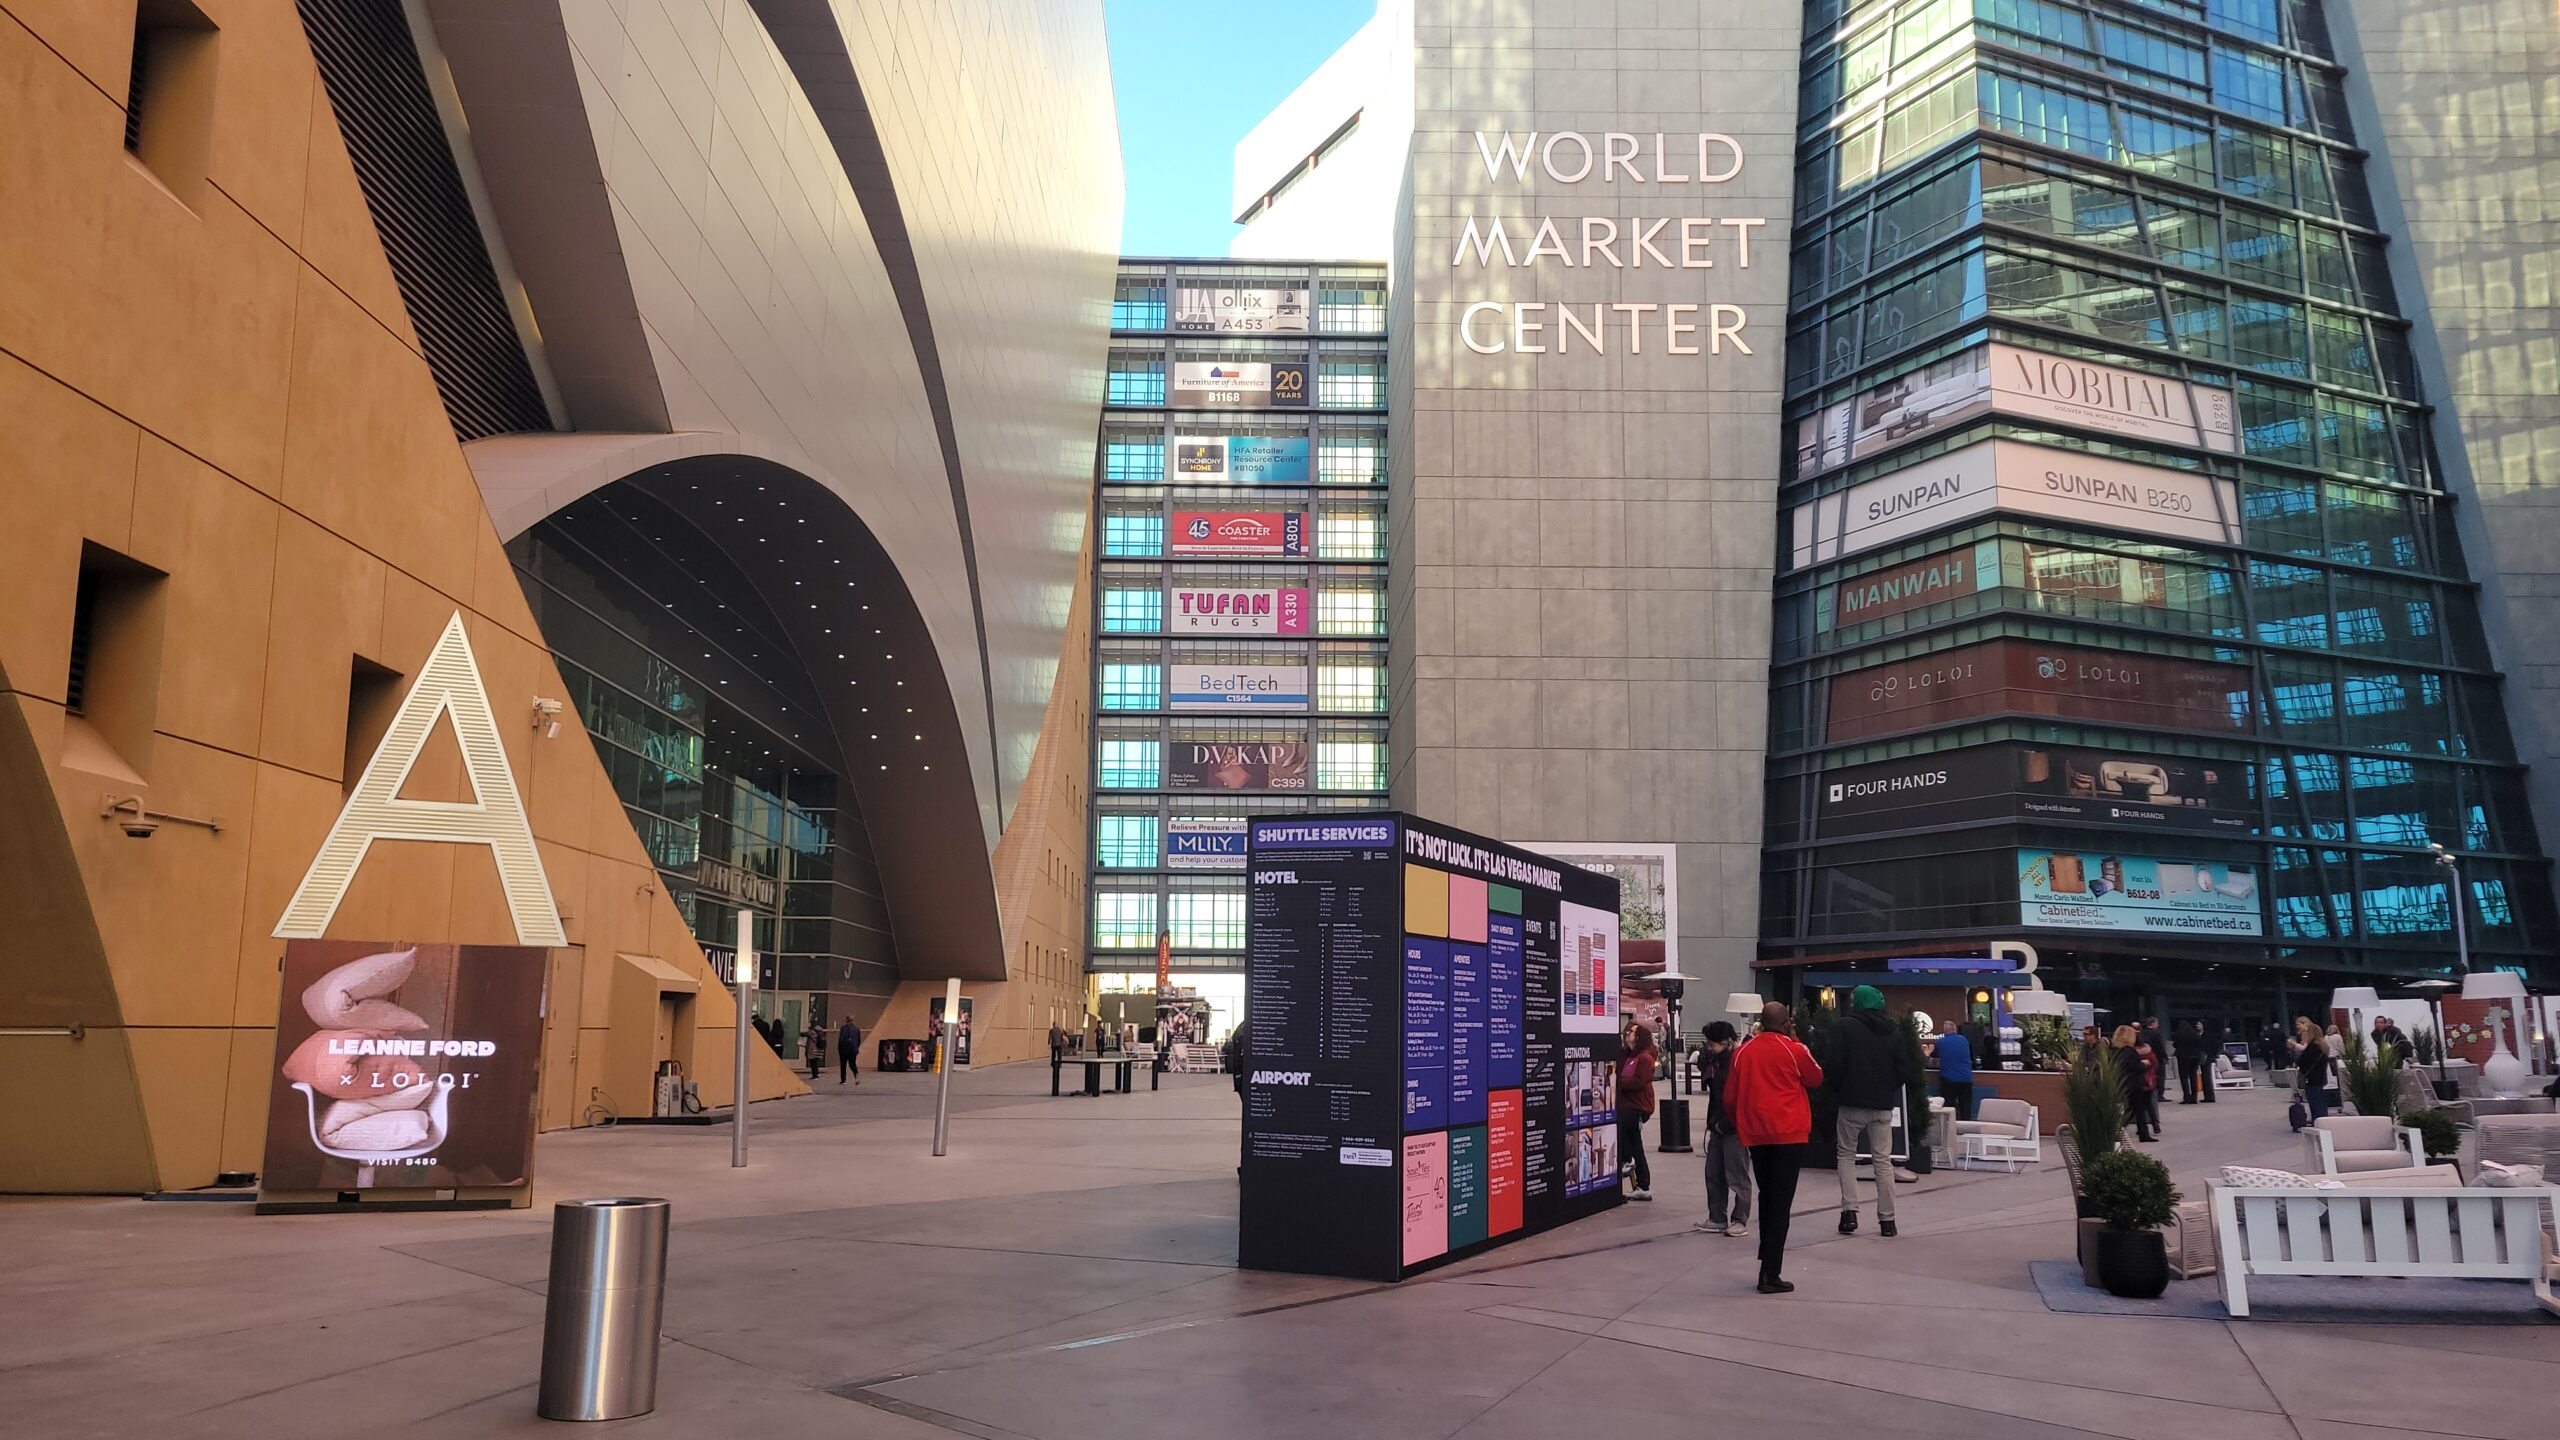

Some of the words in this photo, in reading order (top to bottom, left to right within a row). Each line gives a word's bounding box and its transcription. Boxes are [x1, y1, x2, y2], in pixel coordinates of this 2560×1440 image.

[1474, 130, 1744, 183] WORLD
[1452, 214, 1766, 268] MARKET
[1222, 319, 1263, 330] A453
[1460, 300, 1752, 355] CENTER
[1182, 378, 1220, 386] Furniture
[1221, 378, 1230, 386] of
[1232, 378, 1265, 386] America
[1275, 370, 1303, 390] 20
[2016, 354, 2180, 420] MOBITAL
[1208, 391, 1240, 402] B1168
[1868, 474, 1961, 521] SUNPAN
[2045, 470, 2137, 504] SUNPAN
[2147, 488, 2192, 513] B250
[1188, 520, 1210, 538] 45
[1217, 526, 1270, 536] COASTER
[1286, 518, 1299, 551] A801
[1846, 560, 1962, 613] MANWAH
[1180, 592, 1270, 614] TUFAN
[1191, 618, 1258, 626] RUGS
[1201, 674, 1278, 690] BedTech
[1908, 664, 1972, 690] LOLOI
[2080, 666, 2141, 685] LOLOI
[270, 608, 568, 948] A
[1272, 778, 1305, 788] C399
[1848, 780, 1886, 798] FOUR
[1891, 771, 1947, 790] HANDS
[2121, 810, 2140, 818] FOUR
[2141, 811, 2165, 820] HANDS
[1258, 828, 1319, 842] SHUTTLE
[1321, 827, 1388, 840] SERVICES
[1186, 856, 1202, 864] help
[1405, 828, 1424, 857] IT'S
[1425, 834, 1448, 862] NOT
[1448, 840, 1473, 869] LUCK.
[1474, 848, 1490, 873] IT'S
[1490, 852, 1506, 878] LAS
[1507, 857, 1532, 884] VEGAS
[1532, 864, 1562, 892] MARKET.
[1254, 871, 1298, 884] HOTEL
[2040, 904, 2098, 918] CabinetBed
[1526, 920, 1542, 934] EVENTS
[2144, 915, 2252, 930] www.cabinetbed.ca
[328, 1039, 426, 1056] LEANNE
[429, 1040, 496, 1057] FORD
[1565, 1048, 1590, 1059] DESTINATIONS
[1250, 1070, 1311, 1086] AIRPORT
[368, 1158, 400, 1166] VISIT
[406, 1157, 438, 1166] B480
